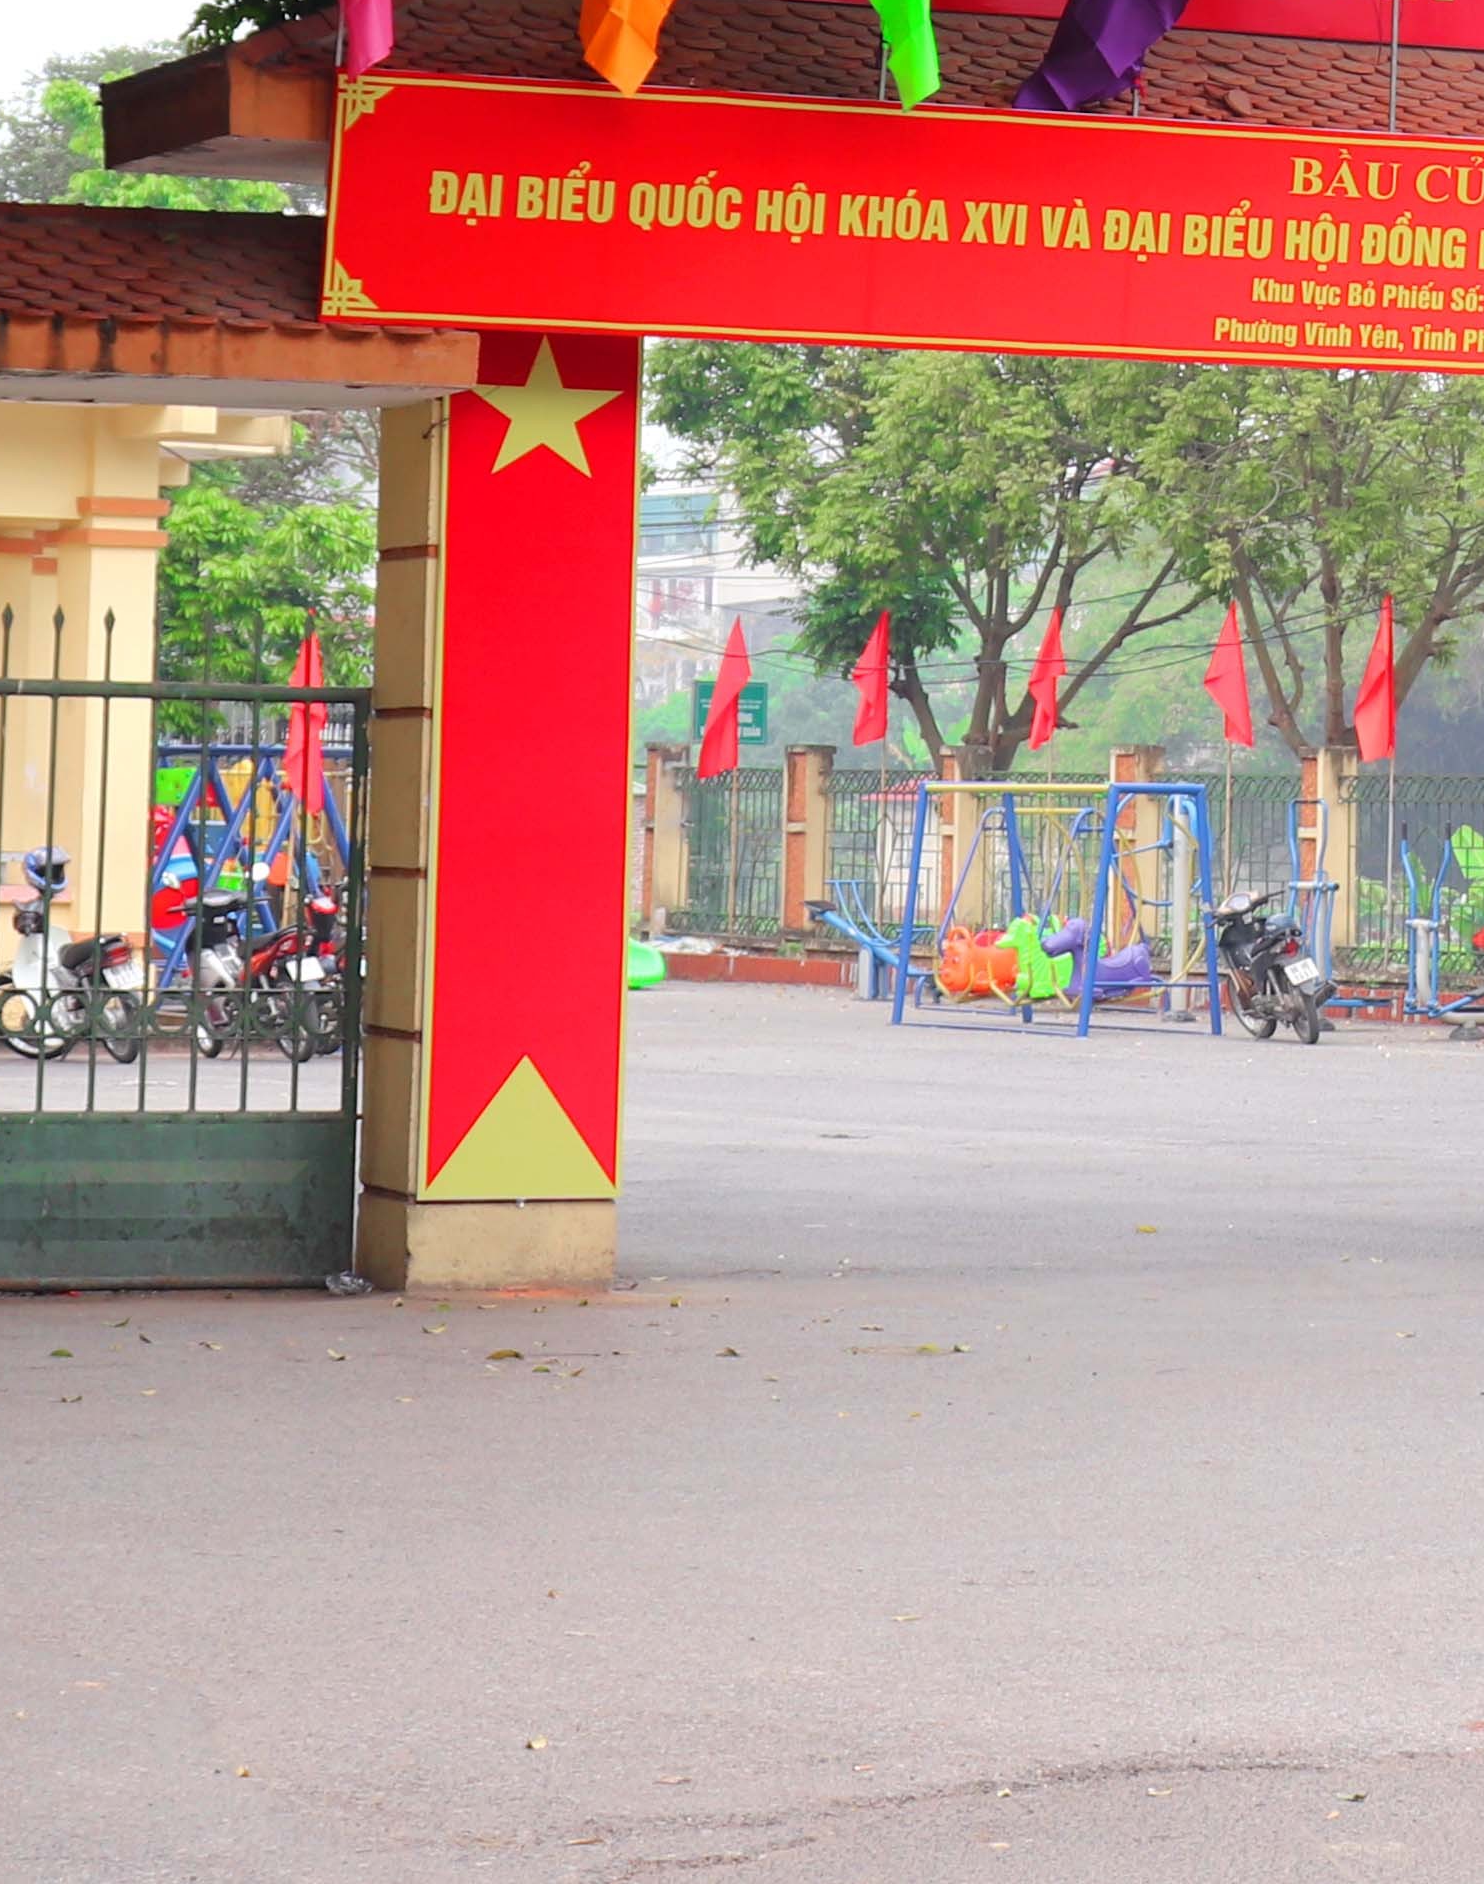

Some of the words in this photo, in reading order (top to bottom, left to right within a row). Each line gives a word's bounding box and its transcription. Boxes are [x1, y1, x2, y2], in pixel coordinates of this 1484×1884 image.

[1289, 148, 1402, 201] BẦU
[428, 170, 504, 227] ĐẠI
[515, 160, 616, 224] BIỂU
[628, 169, 744, 231] QUỐC
[754, 182, 826, 244] HỘI
[837, 189, 949, 242] KHÓA
[960, 200, 1028, 247] XVI
[1040, 198, 1091, 250] VÀ
[1103, 209, 1172, 263] ĐẠI
[1182, 199, 1273, 260] BIỂU
[1283, 213, 1349, 273] HỘI
[1361, 211, 1467, 270] ĐỒNG
[1252, 277, 1295, 304] Khu
[1301, 280, 1341, 311] Vực
[1347, 280, 1377, 309] Bỏ
[1382, 281, 1444, 311] Phiếu
[1450, 285, 1484, 313] Số:
[1214, 316, 1298, 348] Phường
[1304, 321, 1353, 348] Vĩnh
[1358, 324, 1405, 353] Yên,
[1411, 324, 1457, 352] Tỉnh
